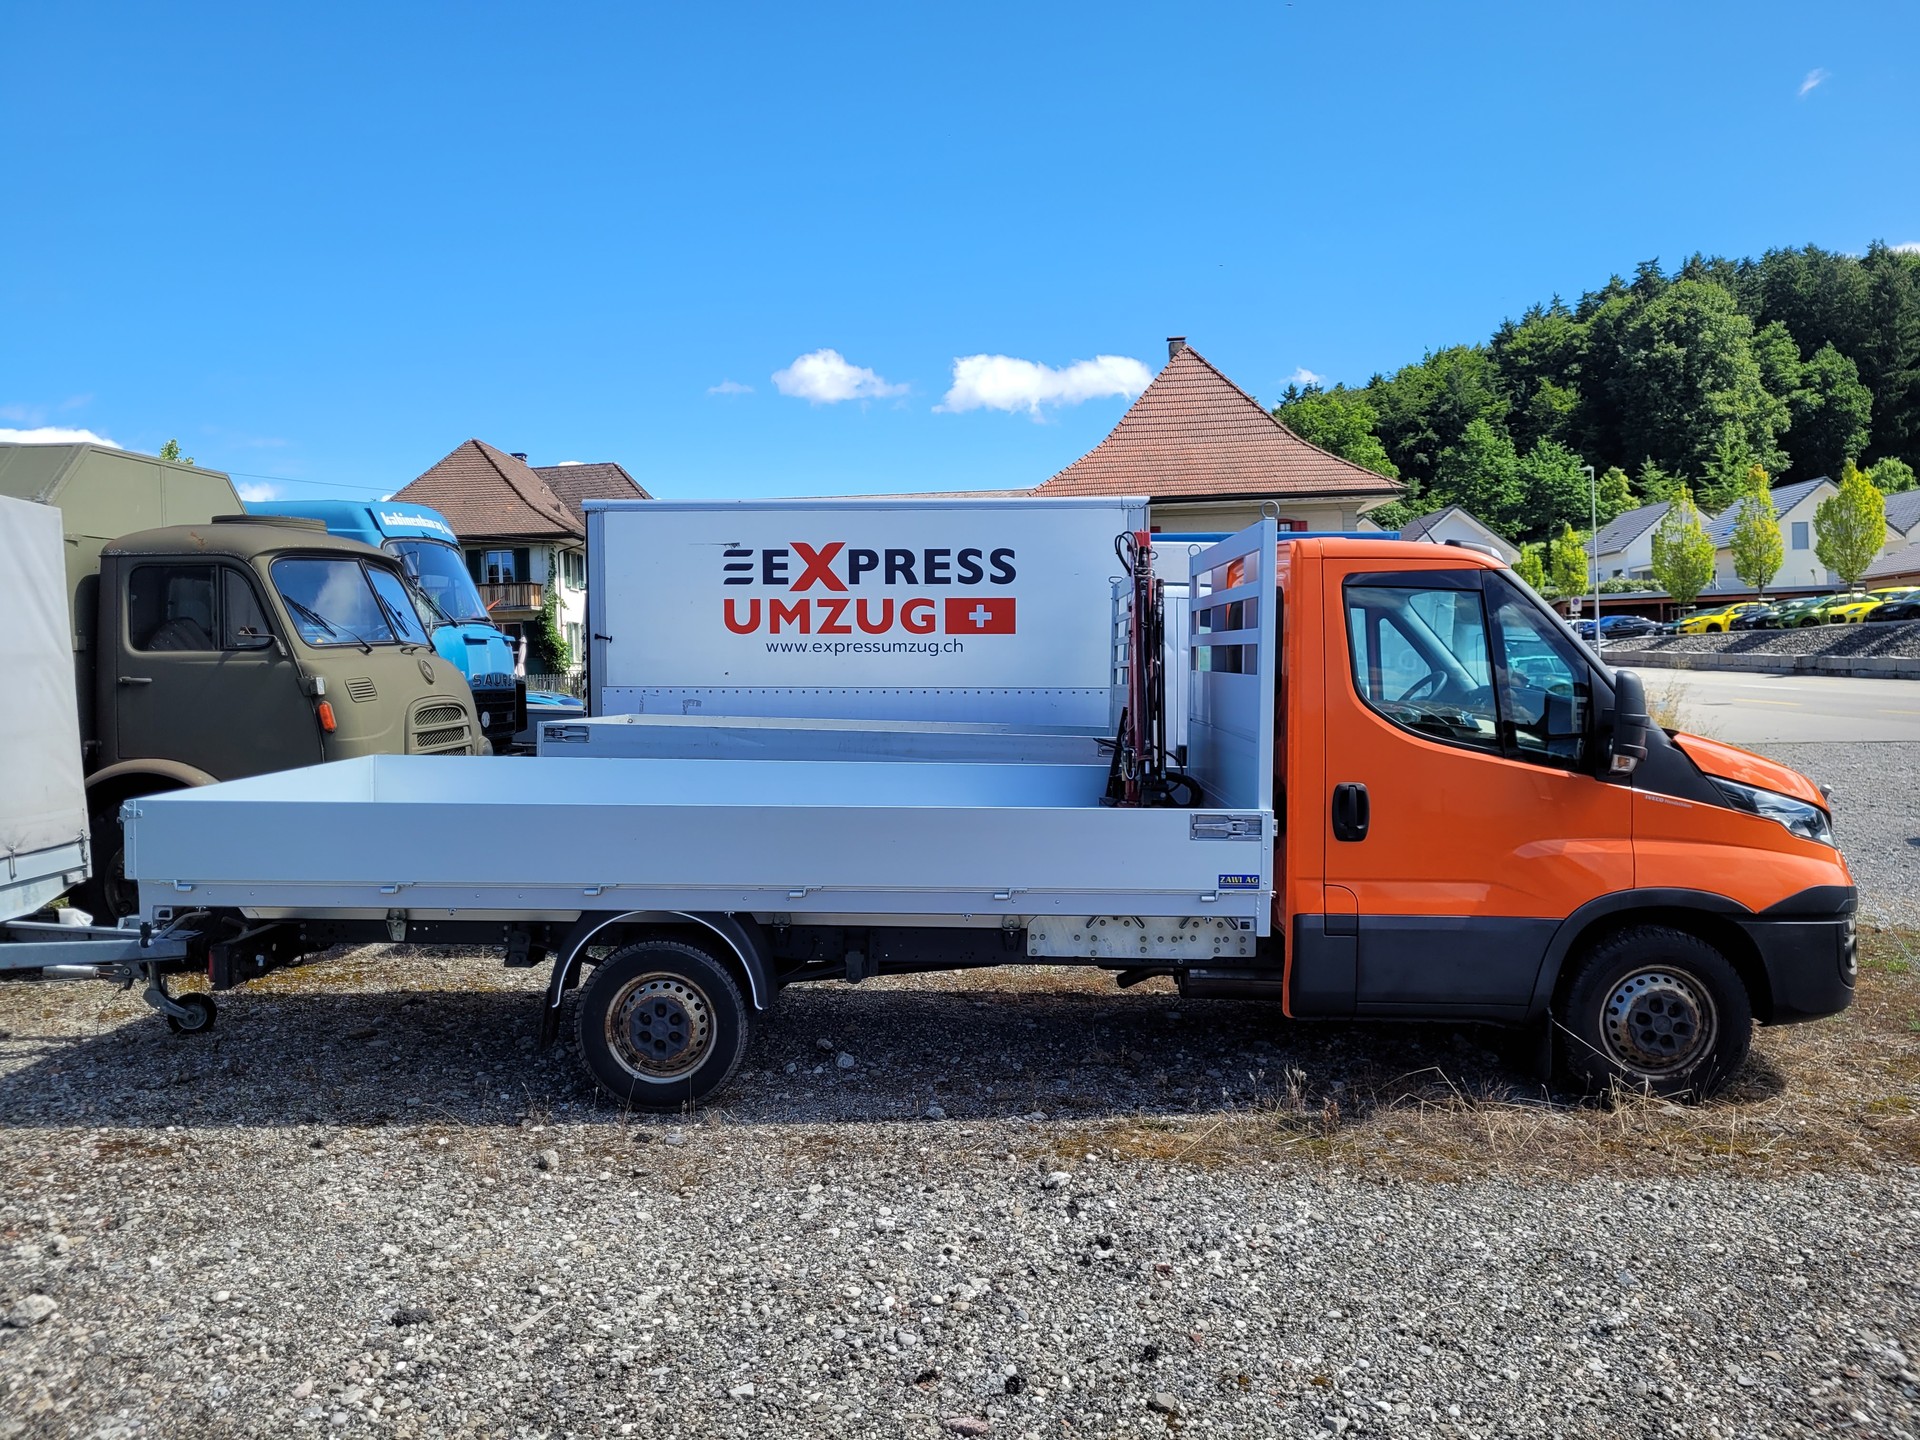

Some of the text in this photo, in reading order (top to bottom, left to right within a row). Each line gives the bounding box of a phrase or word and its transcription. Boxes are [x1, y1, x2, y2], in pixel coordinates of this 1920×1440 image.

[761, 541, 1017, 592] EXPRESS
[723, 597, 936, 635] UMZUG
[765, 638, 964, 657] www.expressumzug.ch
